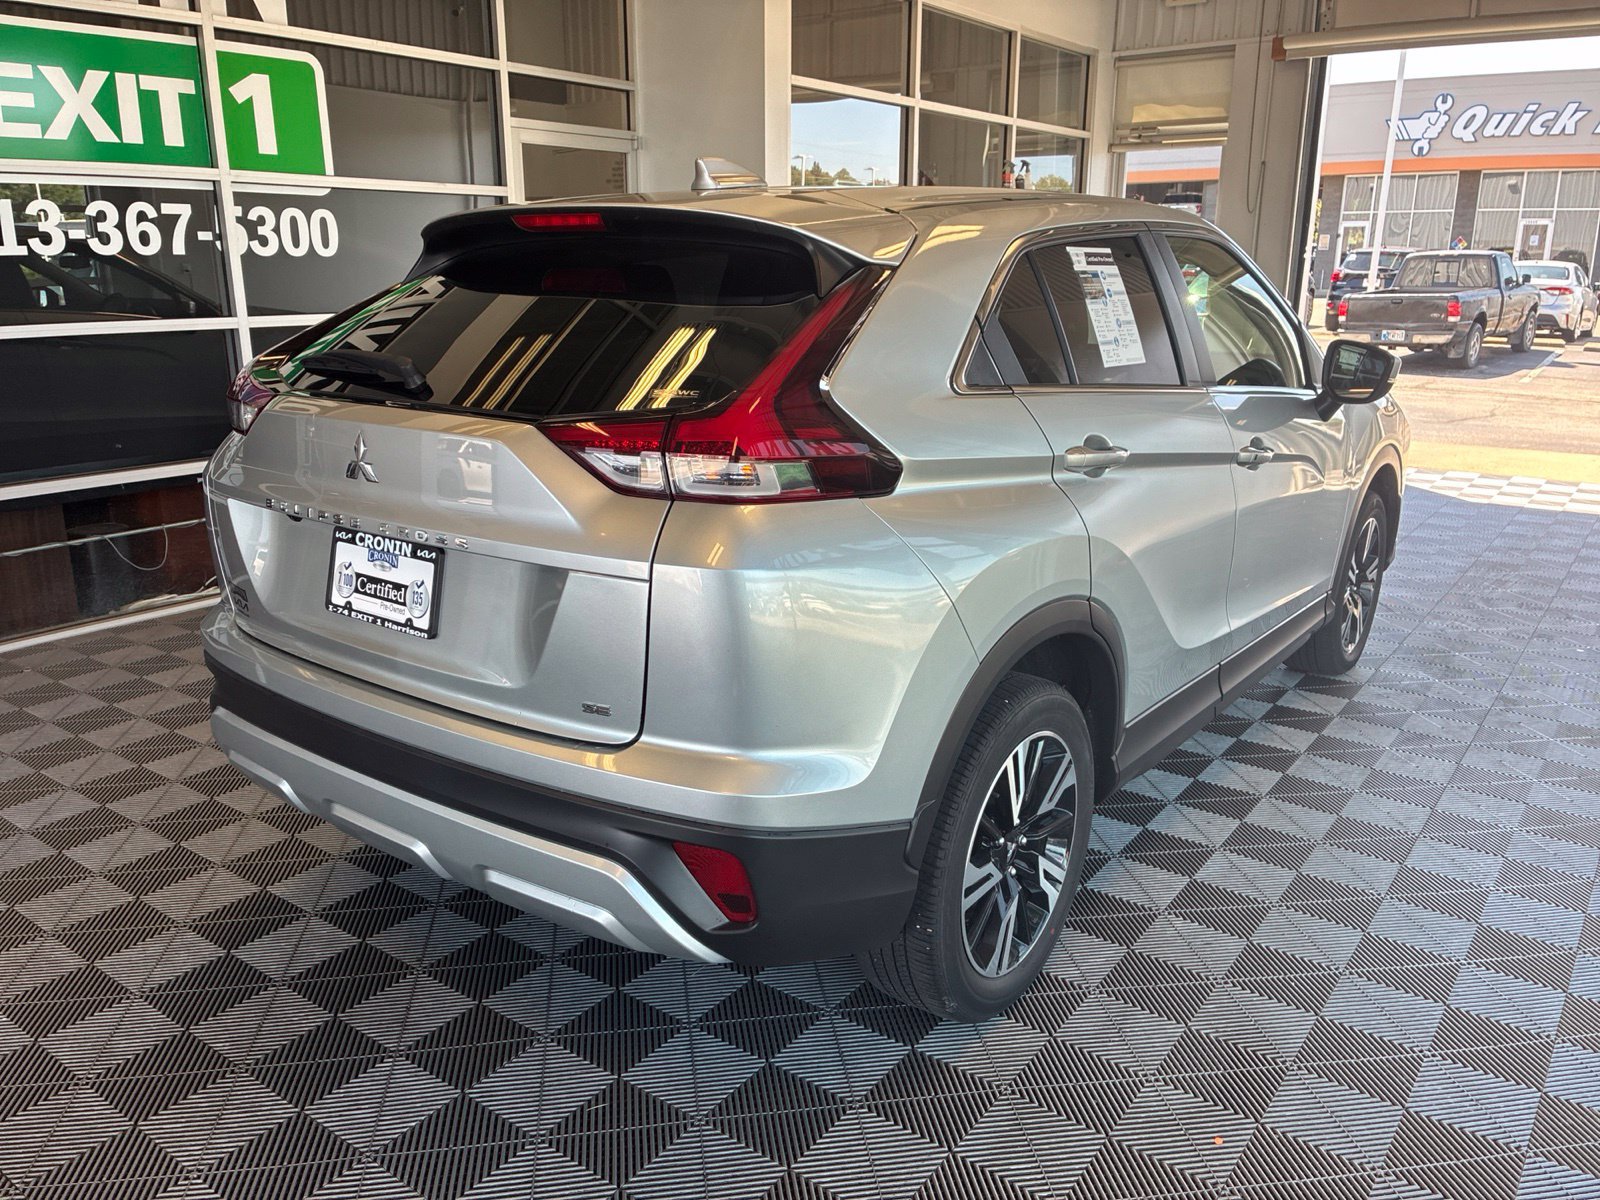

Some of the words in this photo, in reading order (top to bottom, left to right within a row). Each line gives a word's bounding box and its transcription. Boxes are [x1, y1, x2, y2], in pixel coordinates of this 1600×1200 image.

[0, 62, 196, 147] EXIT
[228, 73, 279, 156] 1
[1451, 102, 1592, 143] Quick
[265, 498, 361, 529] ECLIPSE
[379, 522, 470, 550] CROSS
[355, 532, 412, 557] CRONIN
[368, 550, 398, 567] CRONIN
[357, 576, 405, 603] Certified
[412, 590, 424, 606] 135
[328, 604, 349, 616] I-74
[351, 611, 374, 623] EXIT
[375, 618, 382, 626] 1
[384, 620, 428, 639] Harrison
[380, 601, 406, 616] Pre-Owned
